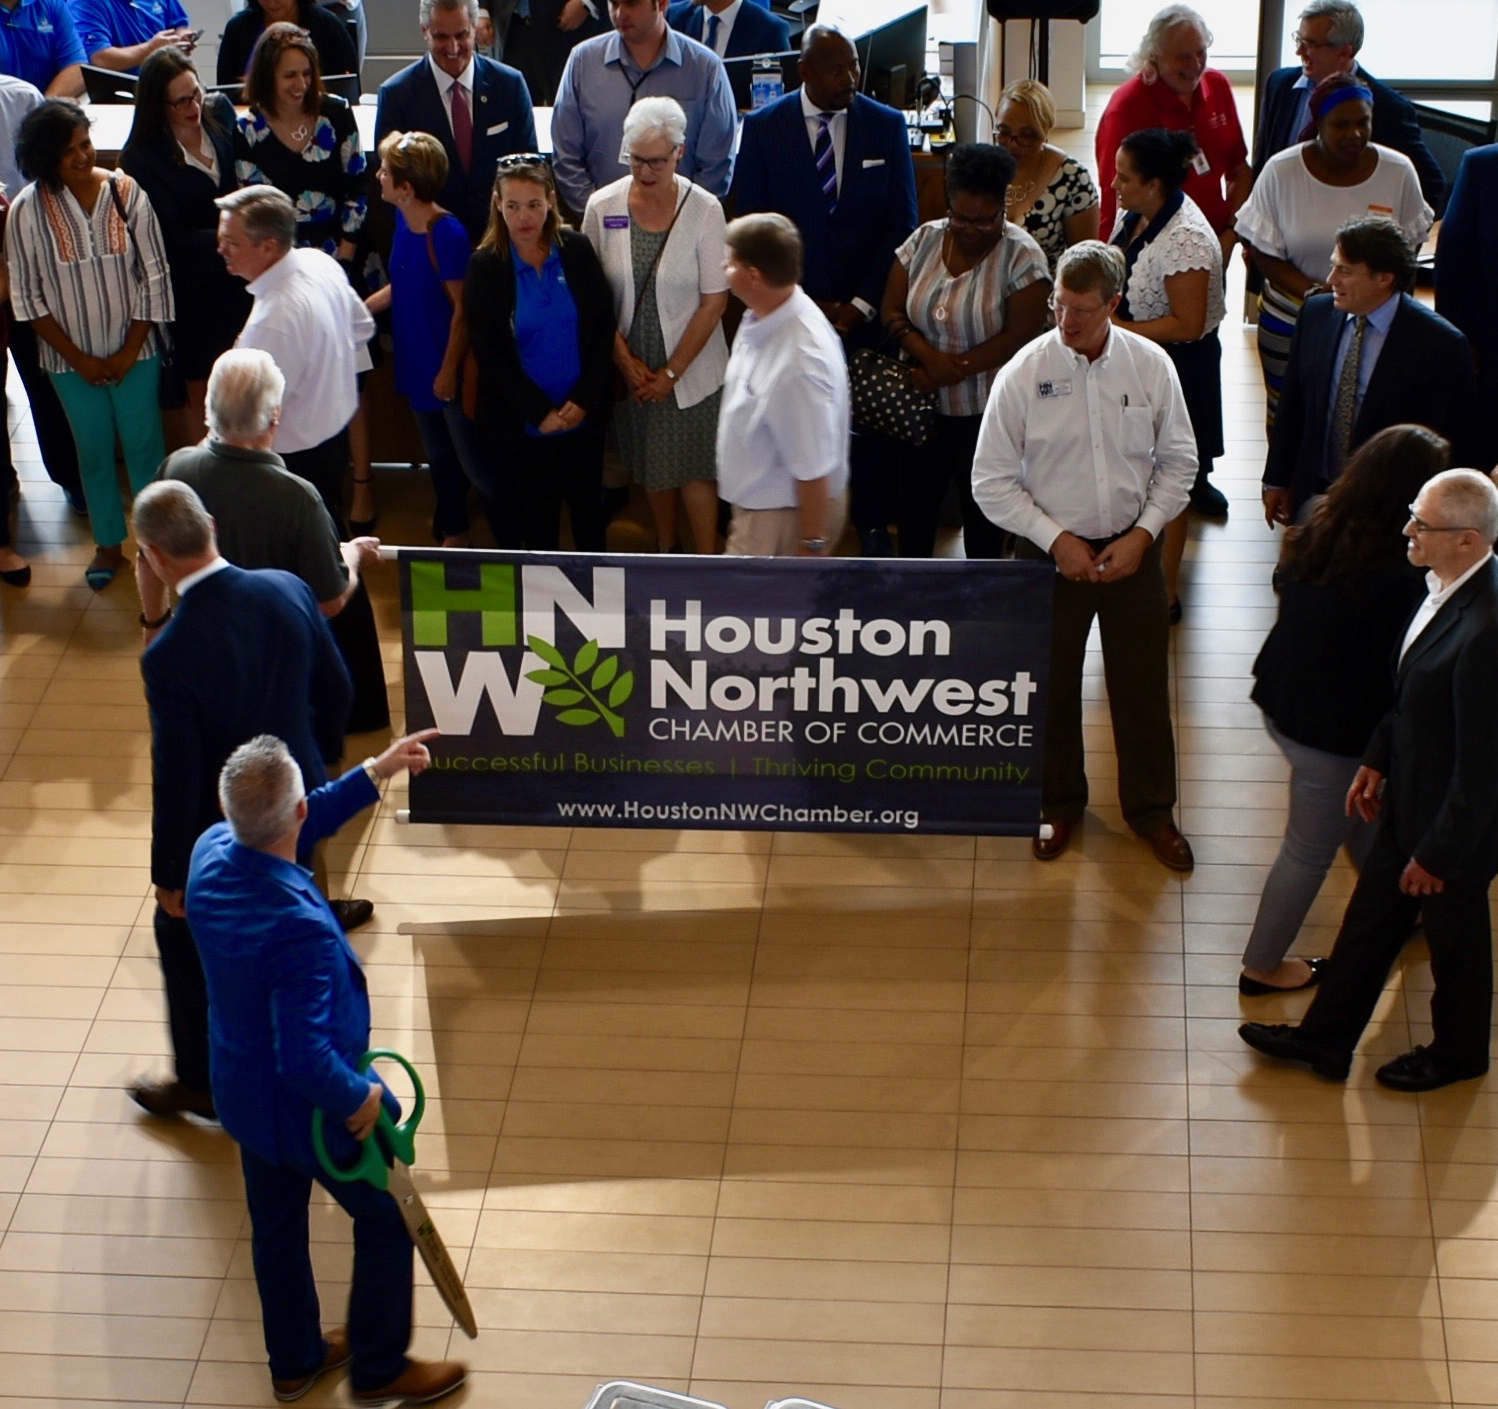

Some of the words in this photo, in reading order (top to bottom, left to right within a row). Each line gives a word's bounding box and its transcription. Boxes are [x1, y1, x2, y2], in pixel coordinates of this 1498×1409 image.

[650, 599, 951, 657] Houston
[414, 651, 551, 736] W
[650, 657, 1038, 716] Northwest
[648, 717, 794, 743] CHAMBER
[804, 721, 846, 744] OF
[858, 722, 1034, 747] COMMERCE
[575, 752, 715, 775] Businesses
[753, 757, 856, 783] Thriving
[866, 758, 1031, 785] Community
[557, 801, 919, 829] www.HoustonNWChamber.org
